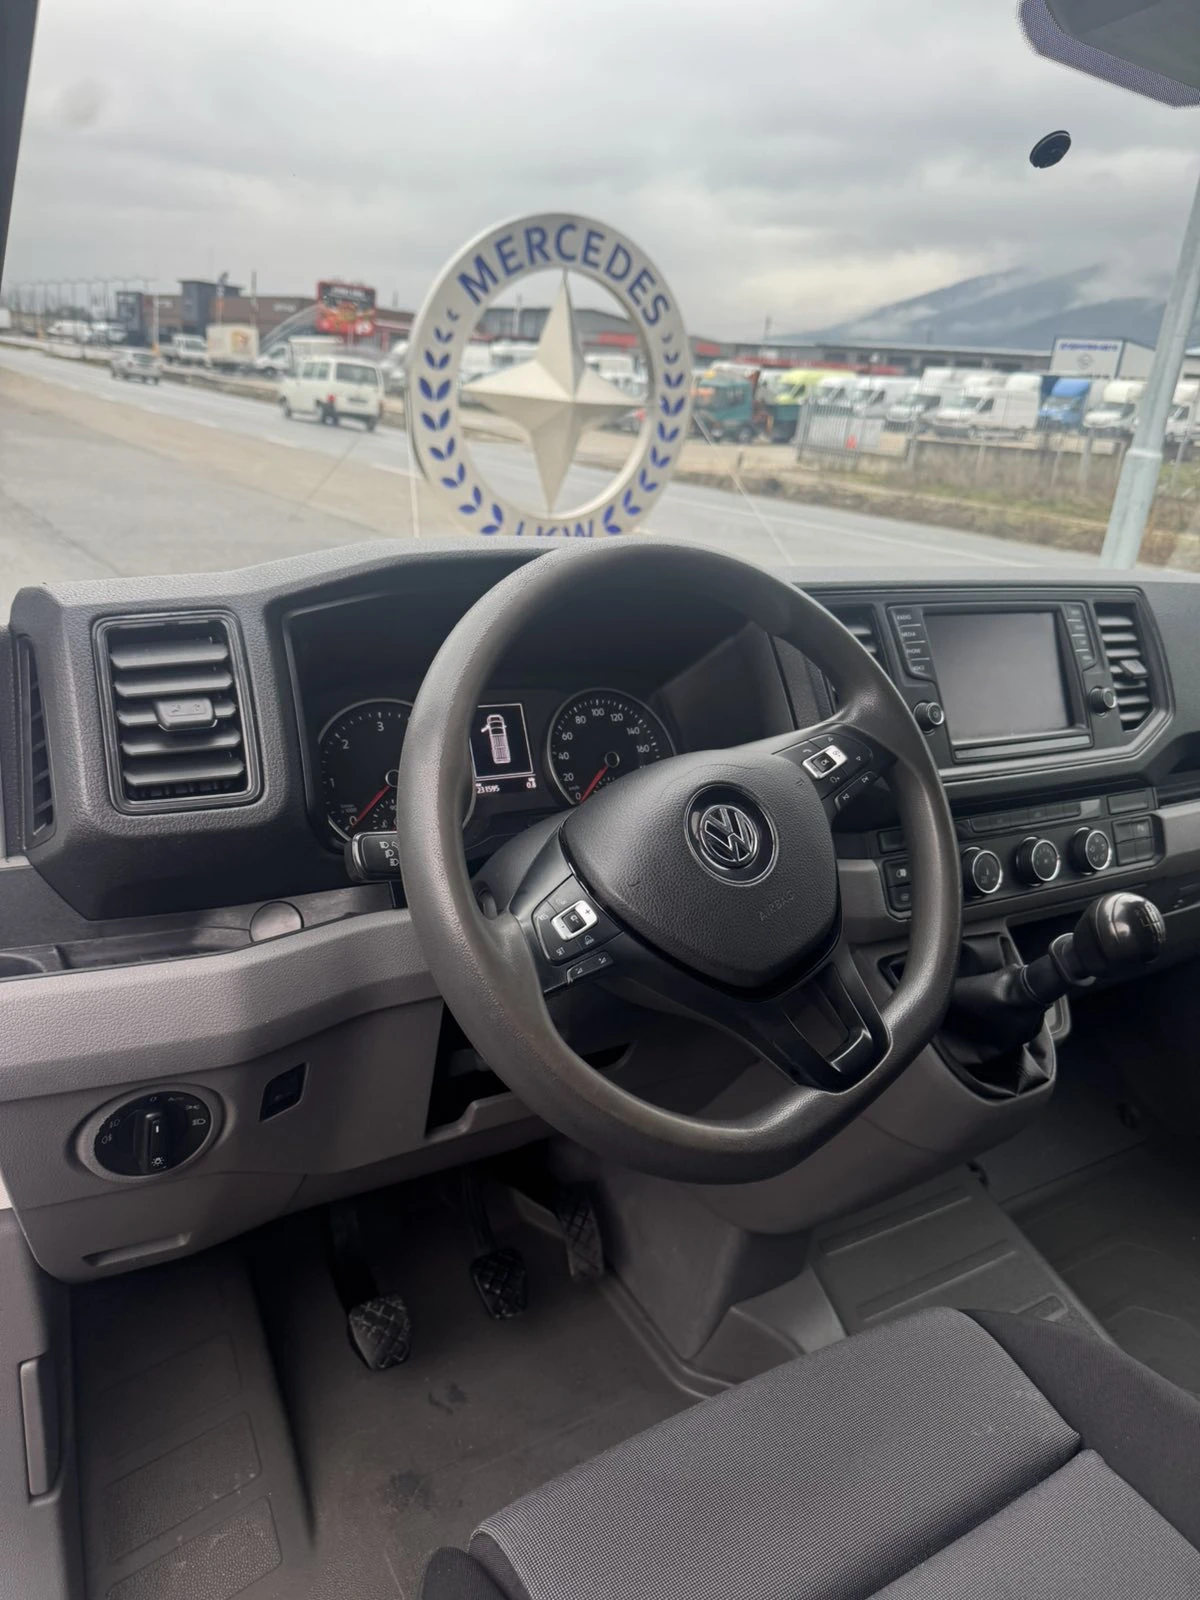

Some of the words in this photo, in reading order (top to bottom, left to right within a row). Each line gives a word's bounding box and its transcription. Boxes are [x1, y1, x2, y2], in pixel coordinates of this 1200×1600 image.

[457, 223, 670, 326] MERCEDES
[592, 708, 604, 716] 100
[575, 715, 586, 724] 80
[610, 713, 623, 721] 120
[376, 721, 384, 731] 3
[627, 727, 640, 735] 140
[562, 732, 573, 740] 60
[341, 739, 349, 749] 2
[636, 744, 650, 752] 160
[558, 751, 569, 760] 40
[563, 773, 574, 781] 20
[349, 815, 357, 825] 0
